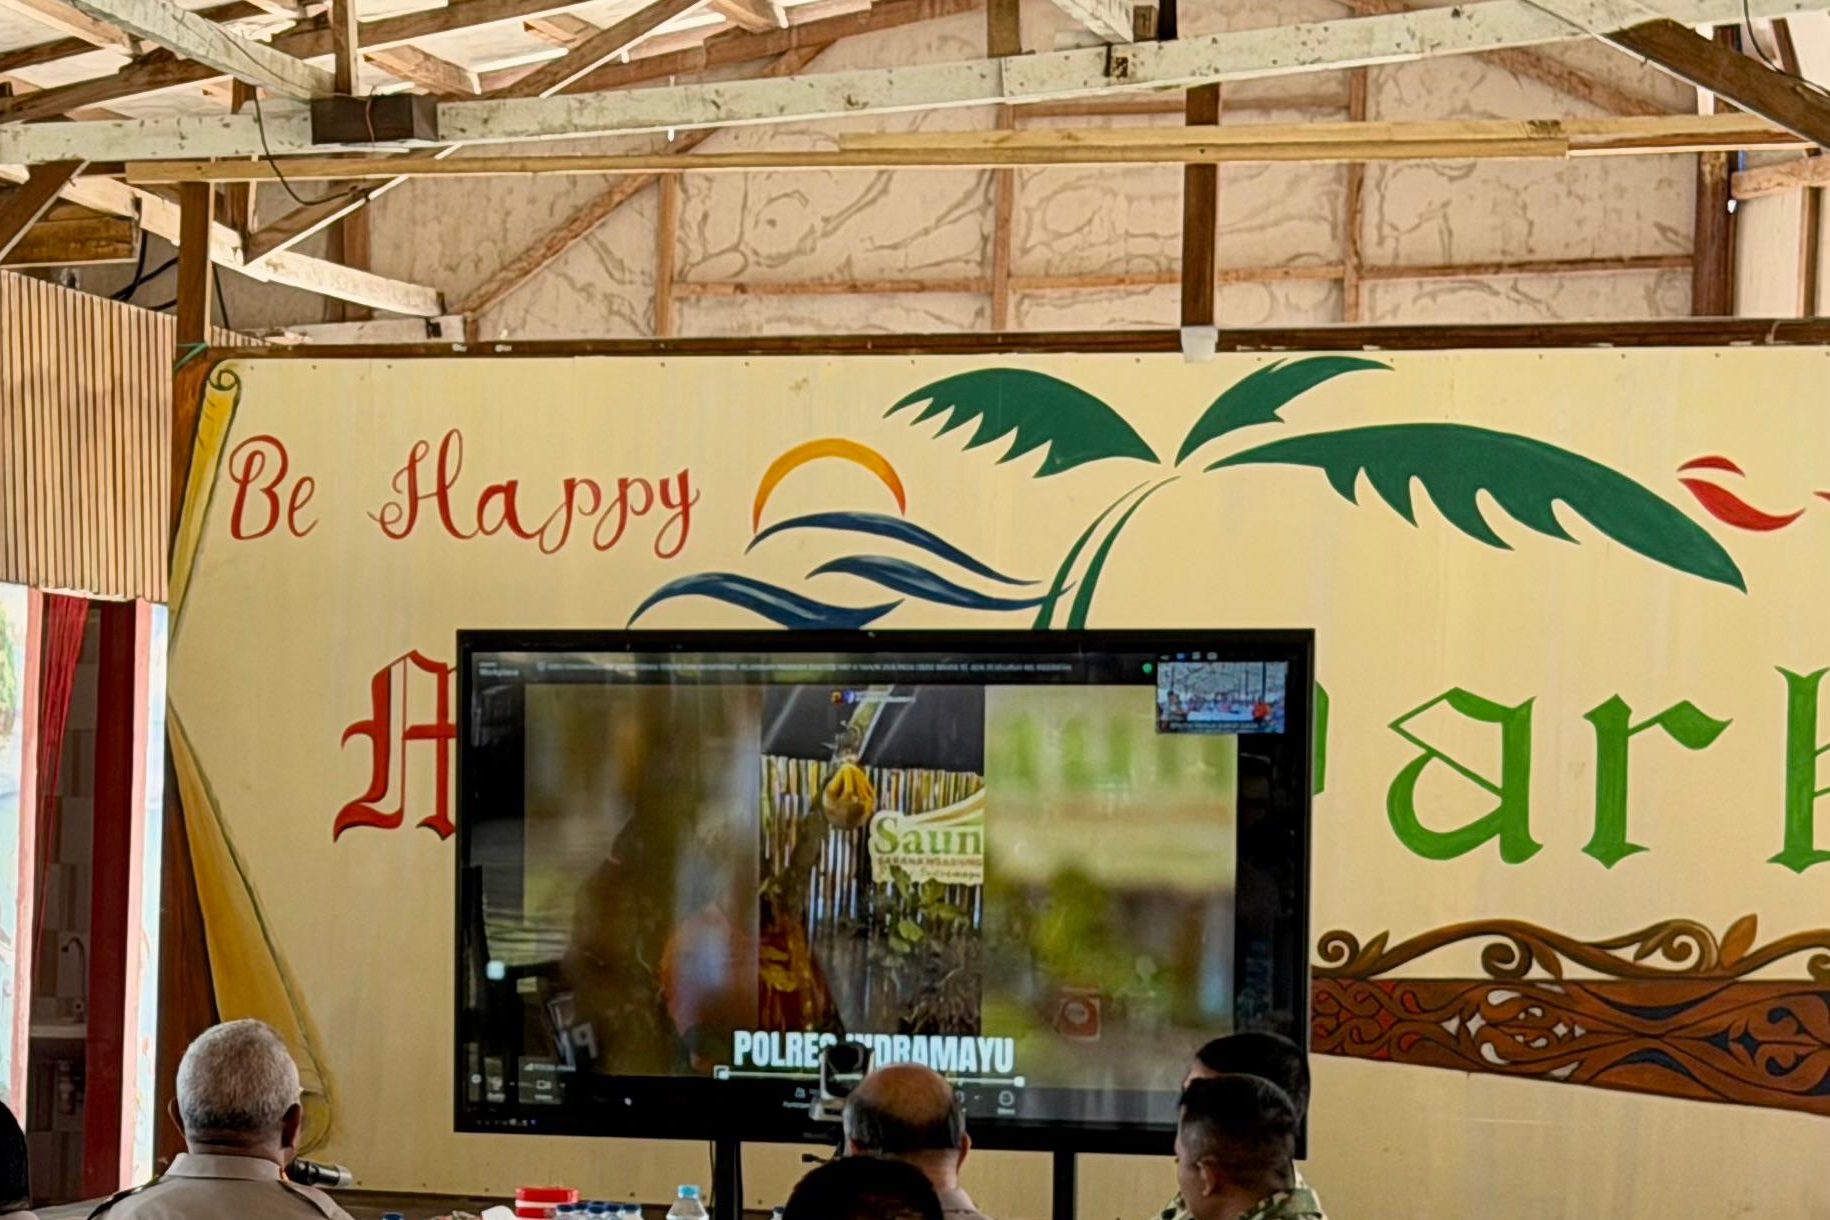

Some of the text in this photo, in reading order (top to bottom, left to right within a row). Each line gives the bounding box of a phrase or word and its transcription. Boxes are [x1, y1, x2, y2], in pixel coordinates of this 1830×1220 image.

[228, 428, 701, 560] Be Happy
[1312, 665, 1830, 874] ark
